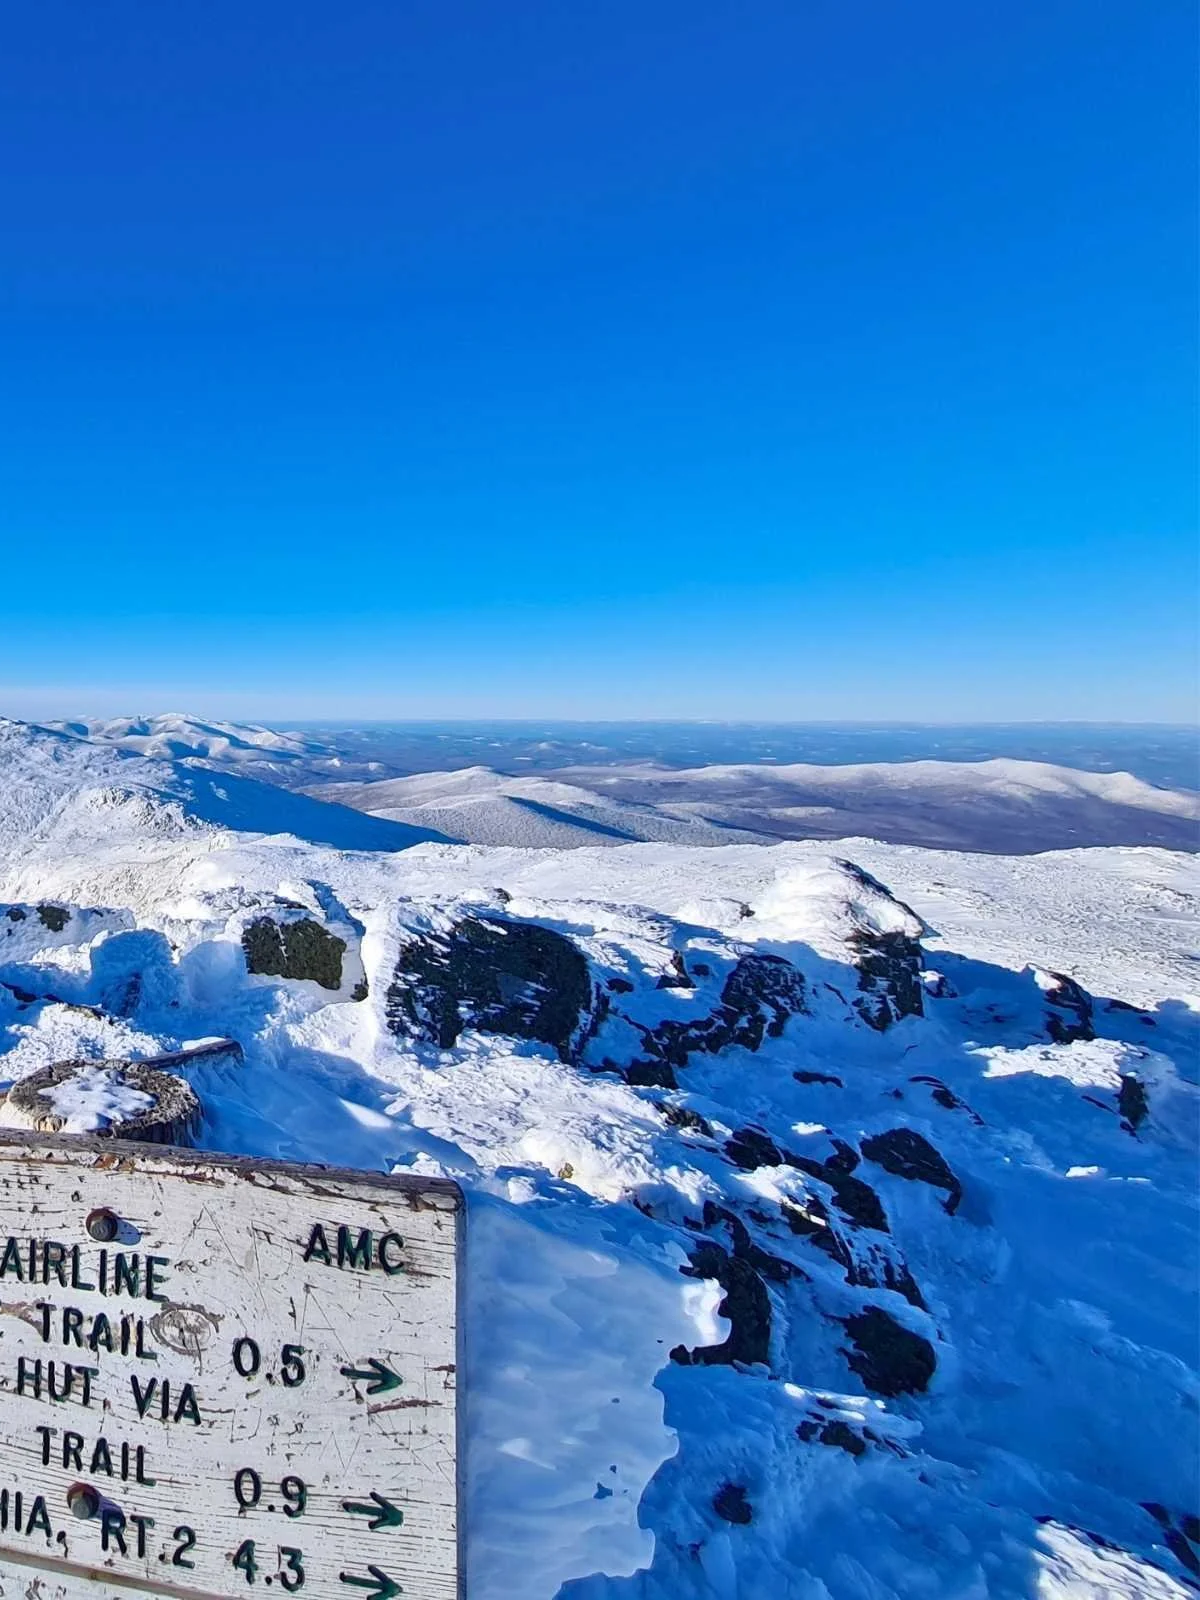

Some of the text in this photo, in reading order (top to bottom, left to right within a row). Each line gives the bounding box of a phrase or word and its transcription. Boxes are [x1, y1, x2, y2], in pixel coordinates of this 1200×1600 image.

[0, 1237, 170, 1302] AIRLINE
[303, 1223, 405, 1275] AMC
[36, 1302, 157, 1360] TRAIL
[232, 1337, 306, 1387] 0.5
[17, 1356, 99, 1407] HUT
[130, 1374, 202, 1426] VIA
[36, 1425, 157, 1487] TRAIL
[234, 1467, 307, 1518] 0.9
[101, 1506, 196, 1569] RT.2
[232, 1539, 305, 1593] 4.3
